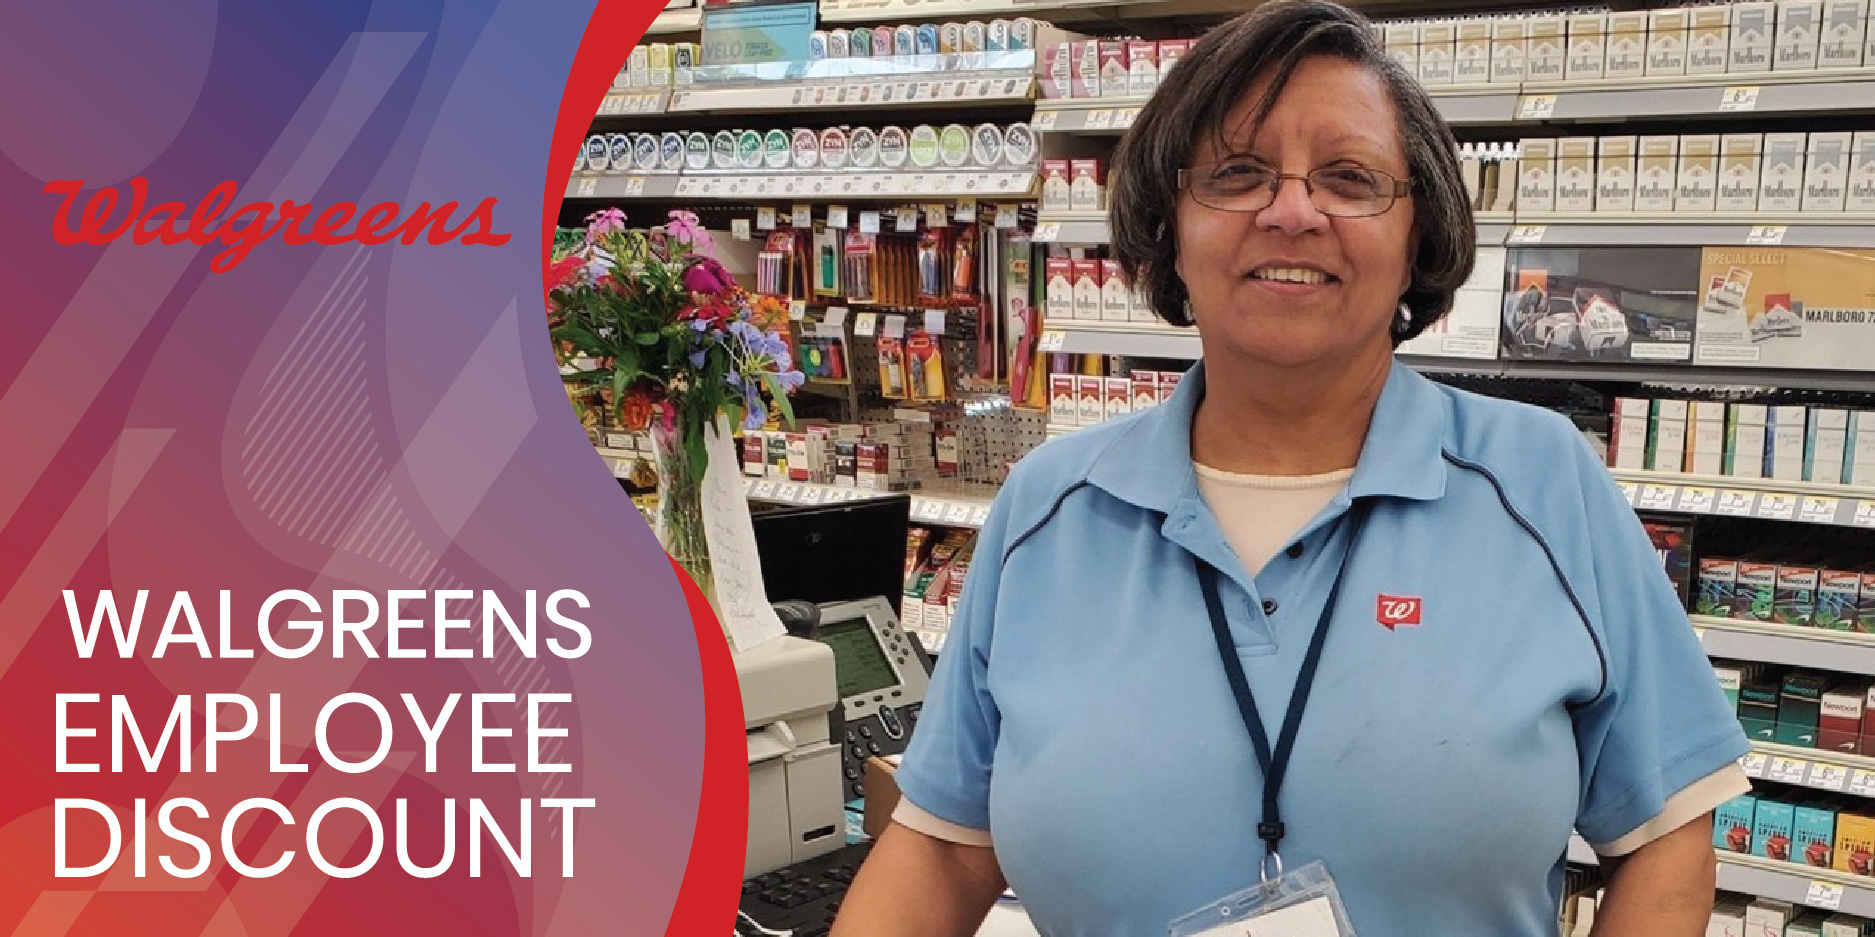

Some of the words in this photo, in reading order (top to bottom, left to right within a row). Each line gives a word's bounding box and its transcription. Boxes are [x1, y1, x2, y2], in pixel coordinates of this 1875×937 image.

[1707, 252, 1746, 265] SPECIAL
[1750, 252, 1786, 265] SELECT
[1805, 310, 1865, 324] MARLBORO
